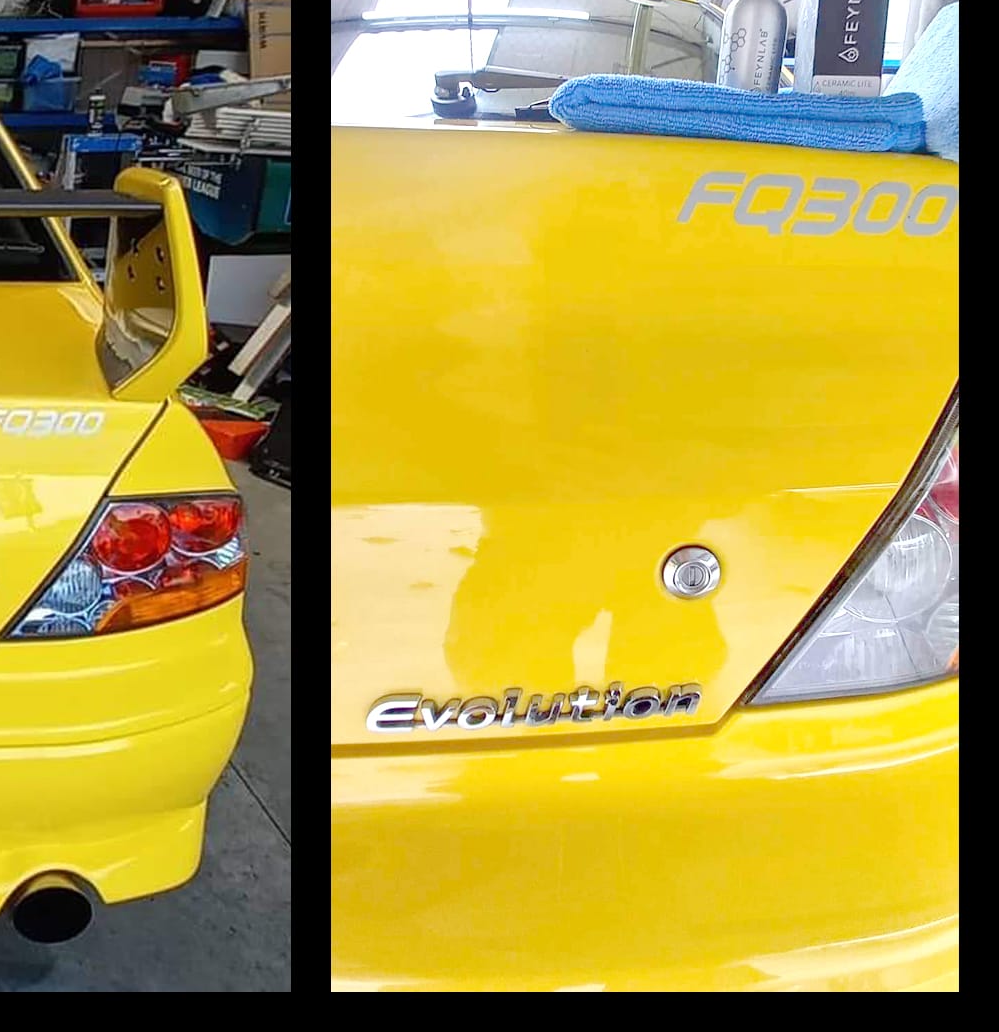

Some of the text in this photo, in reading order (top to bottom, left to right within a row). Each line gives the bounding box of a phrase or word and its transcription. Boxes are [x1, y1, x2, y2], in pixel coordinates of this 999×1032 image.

[753, 30, 768, 86] FEYNLAB
[821, 79, 873, 88] CERAMIC LITE
[677, 171, 959, 238] FQ300
[366, 680, 703, 733] Evolution
